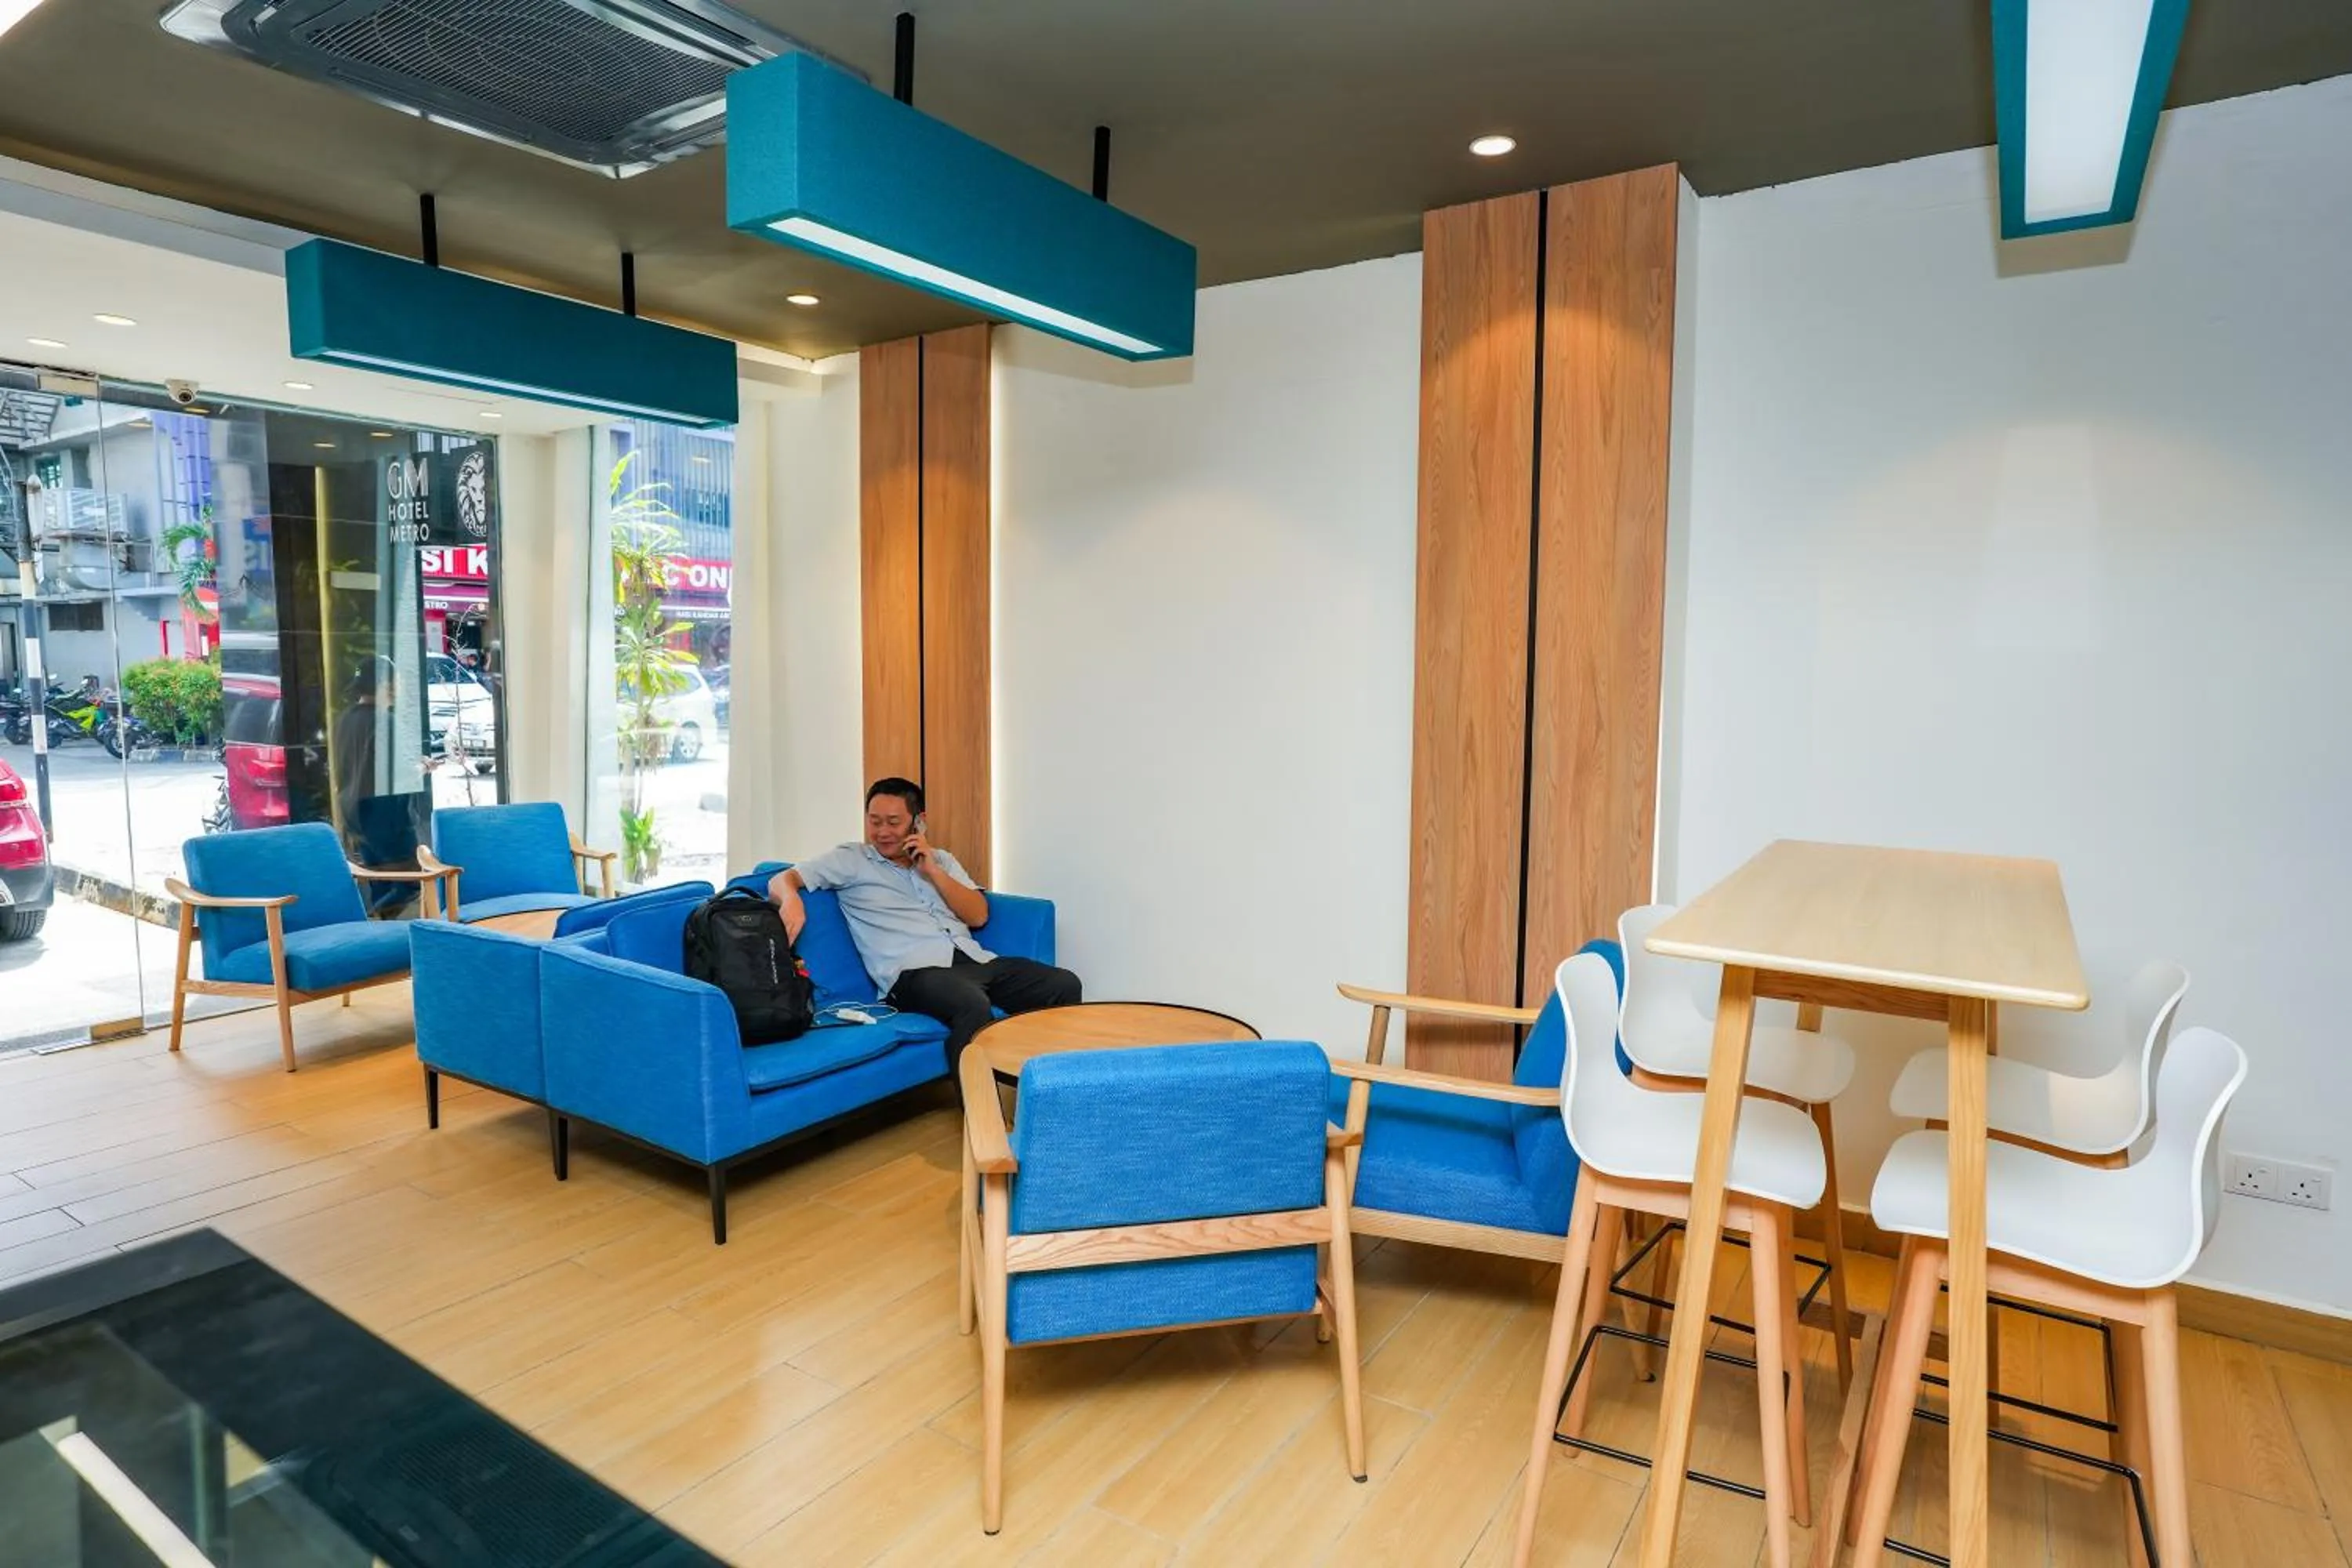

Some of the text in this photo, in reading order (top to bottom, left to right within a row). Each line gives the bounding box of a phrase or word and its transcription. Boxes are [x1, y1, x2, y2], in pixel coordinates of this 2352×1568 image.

[387, 458, 429, 499] GM
[388, 502, 429, 521] HOTEL
[390, 523, 430, 543] METRO
